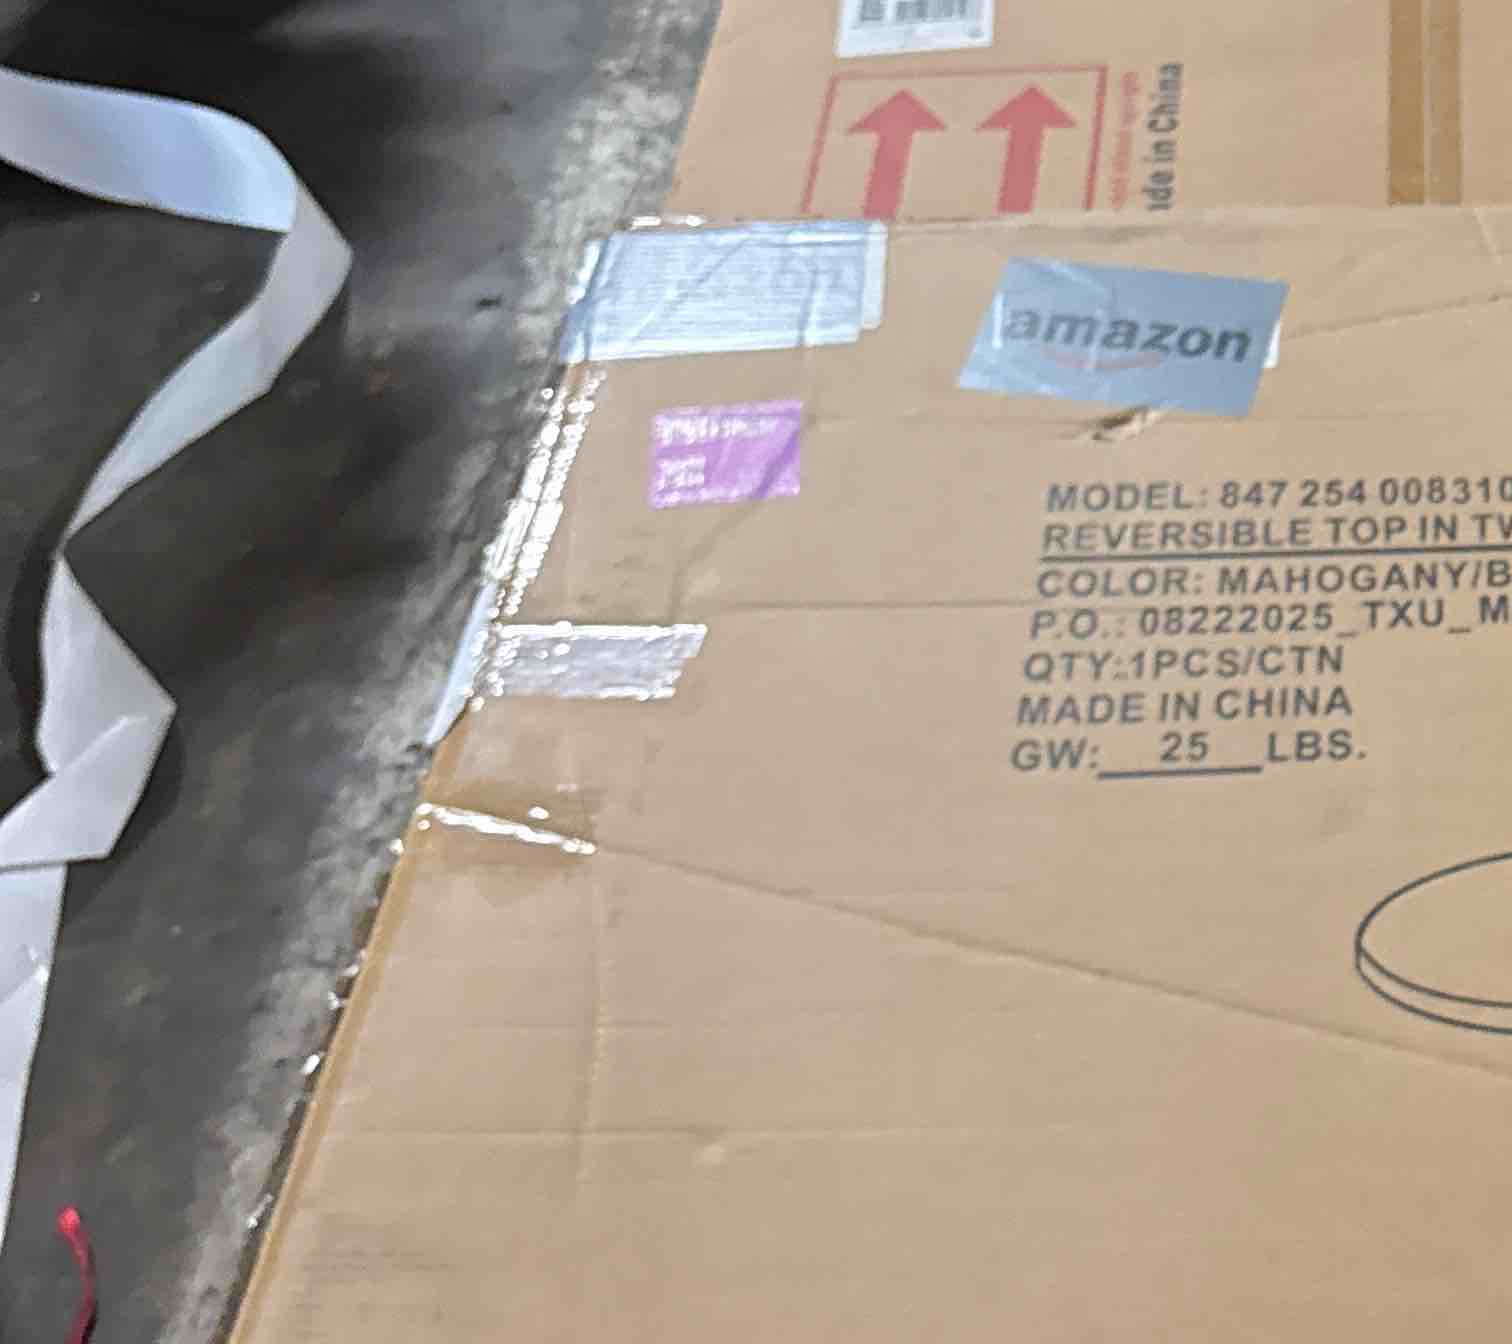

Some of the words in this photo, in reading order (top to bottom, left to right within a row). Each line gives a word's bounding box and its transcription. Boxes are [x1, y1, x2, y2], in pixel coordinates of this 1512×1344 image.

[1144, 63, 1184, 133] China
[1141, 141, 1175, 164] in
[1002, 307, 1252, 363] amazon
[1047, 480, 1209, 513] MODEL:
[1218, 478, 1289, 508] 847
[1299, 476, 1368, 507] 254
[1042, 516, 1313, 552] REVERSIBLE
[1322, 514, 1407, 546] TOP
[1416, 513, 1458, 541] IN
[1036, 565, 1205, 599] COLOR:
[1015, 691, 1148, 726] MADE
[1157, 690, 1201, 721] IN
[1212, 685, 1355, 720] CHINA
[1158, 729, 1211, 763] 25
[1265, 728, 1368, 764] LBS.
